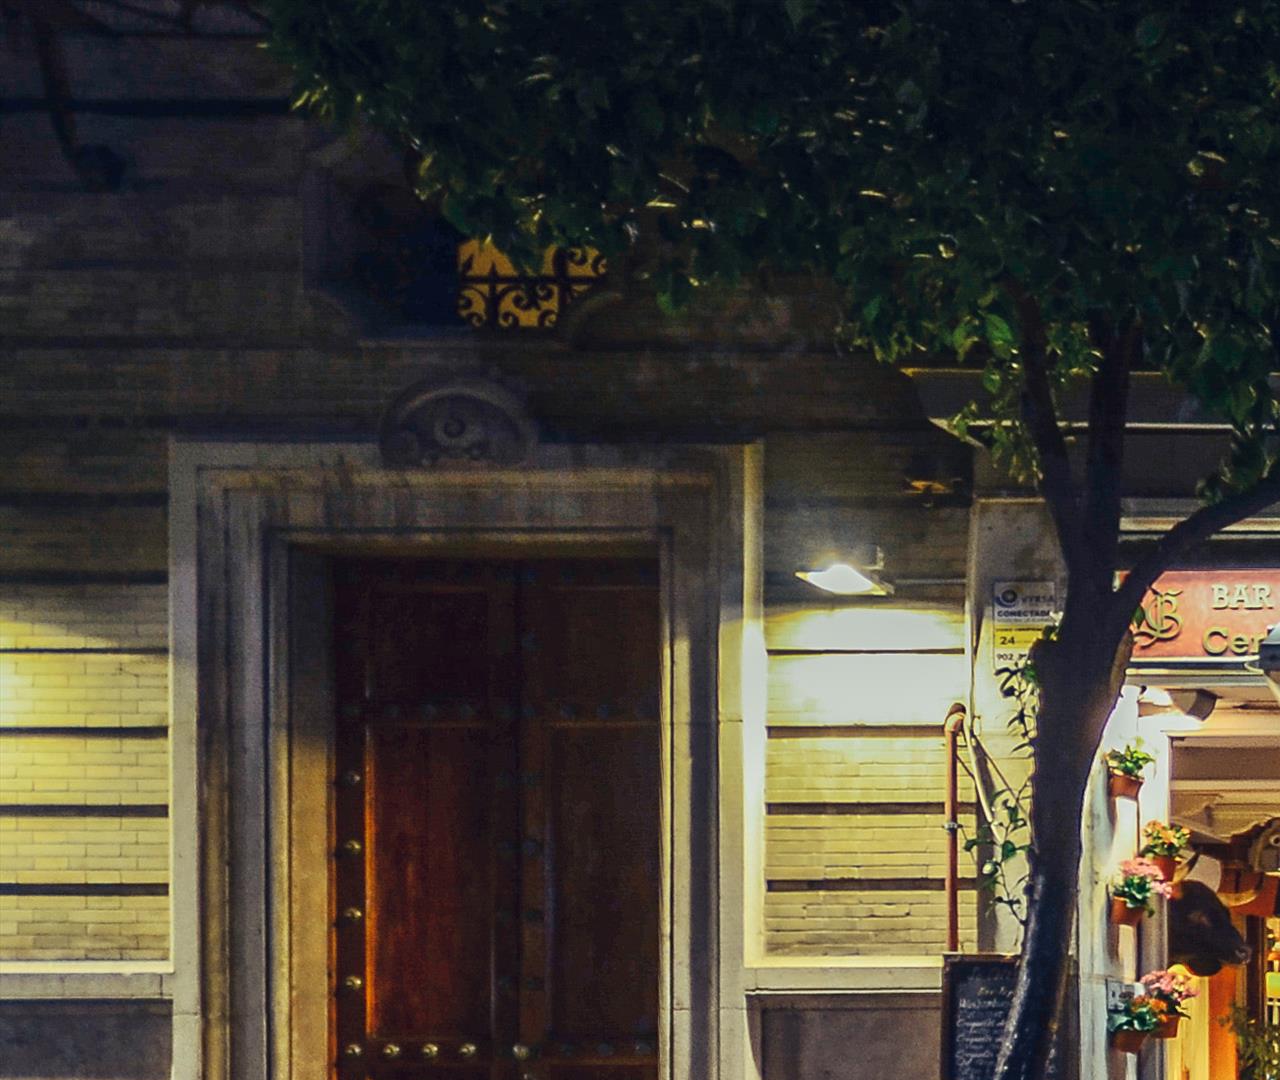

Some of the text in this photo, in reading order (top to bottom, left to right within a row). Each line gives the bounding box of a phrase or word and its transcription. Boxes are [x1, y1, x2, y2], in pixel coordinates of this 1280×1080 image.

[1211, 583, 1274, 609] BAR
[1000, 636, 1016, 645] 24
[1202, 627, 1266, 655] Cer
